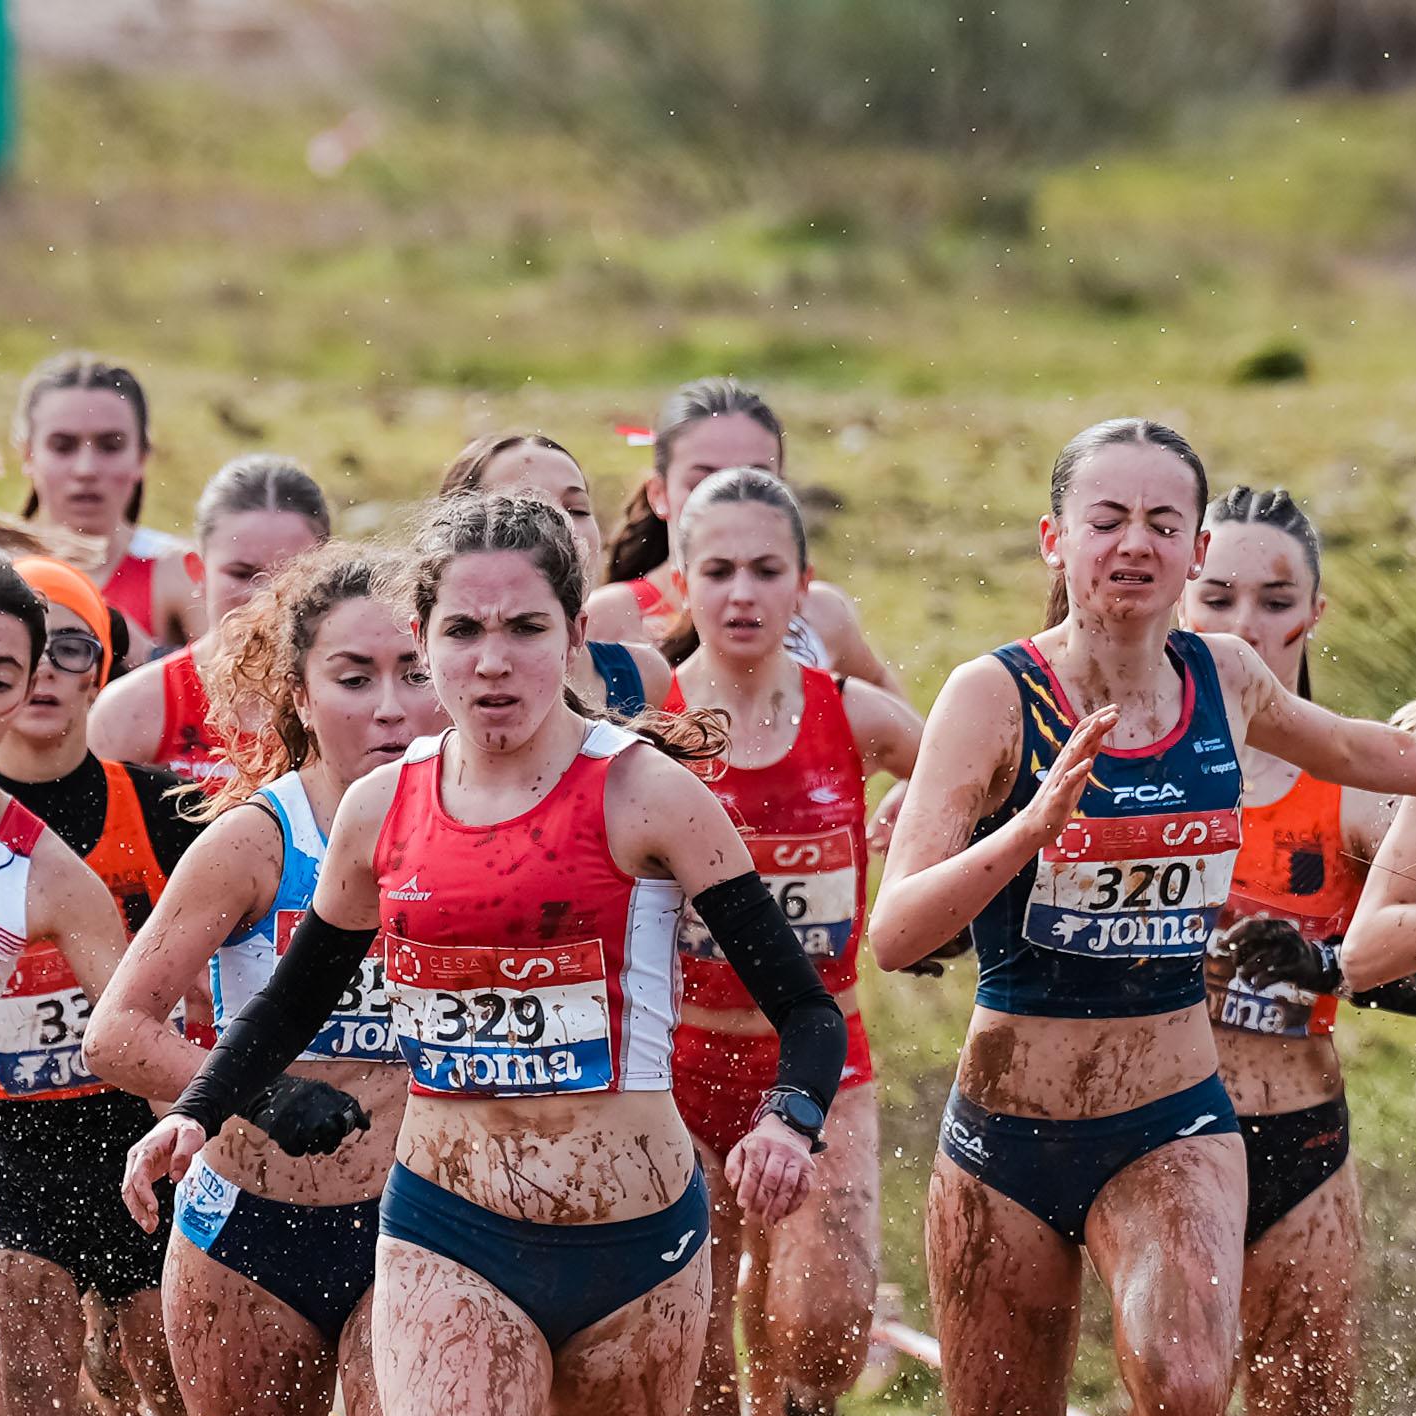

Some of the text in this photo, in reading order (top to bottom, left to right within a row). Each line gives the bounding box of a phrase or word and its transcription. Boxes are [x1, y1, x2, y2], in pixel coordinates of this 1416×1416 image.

[1112, 782, 1185, 804] FCA
[386, 890, 432, 902] MERCURY
[1088, 862, 1191, 911] 320
[1088, 914, 1208, 951] Joma
[429, 955, 482, 969] CESA
[36, 992, 93, 1046] 33
[436, 992, 545, 1044] 329
[448, 1050, 582, 1088] Joma
